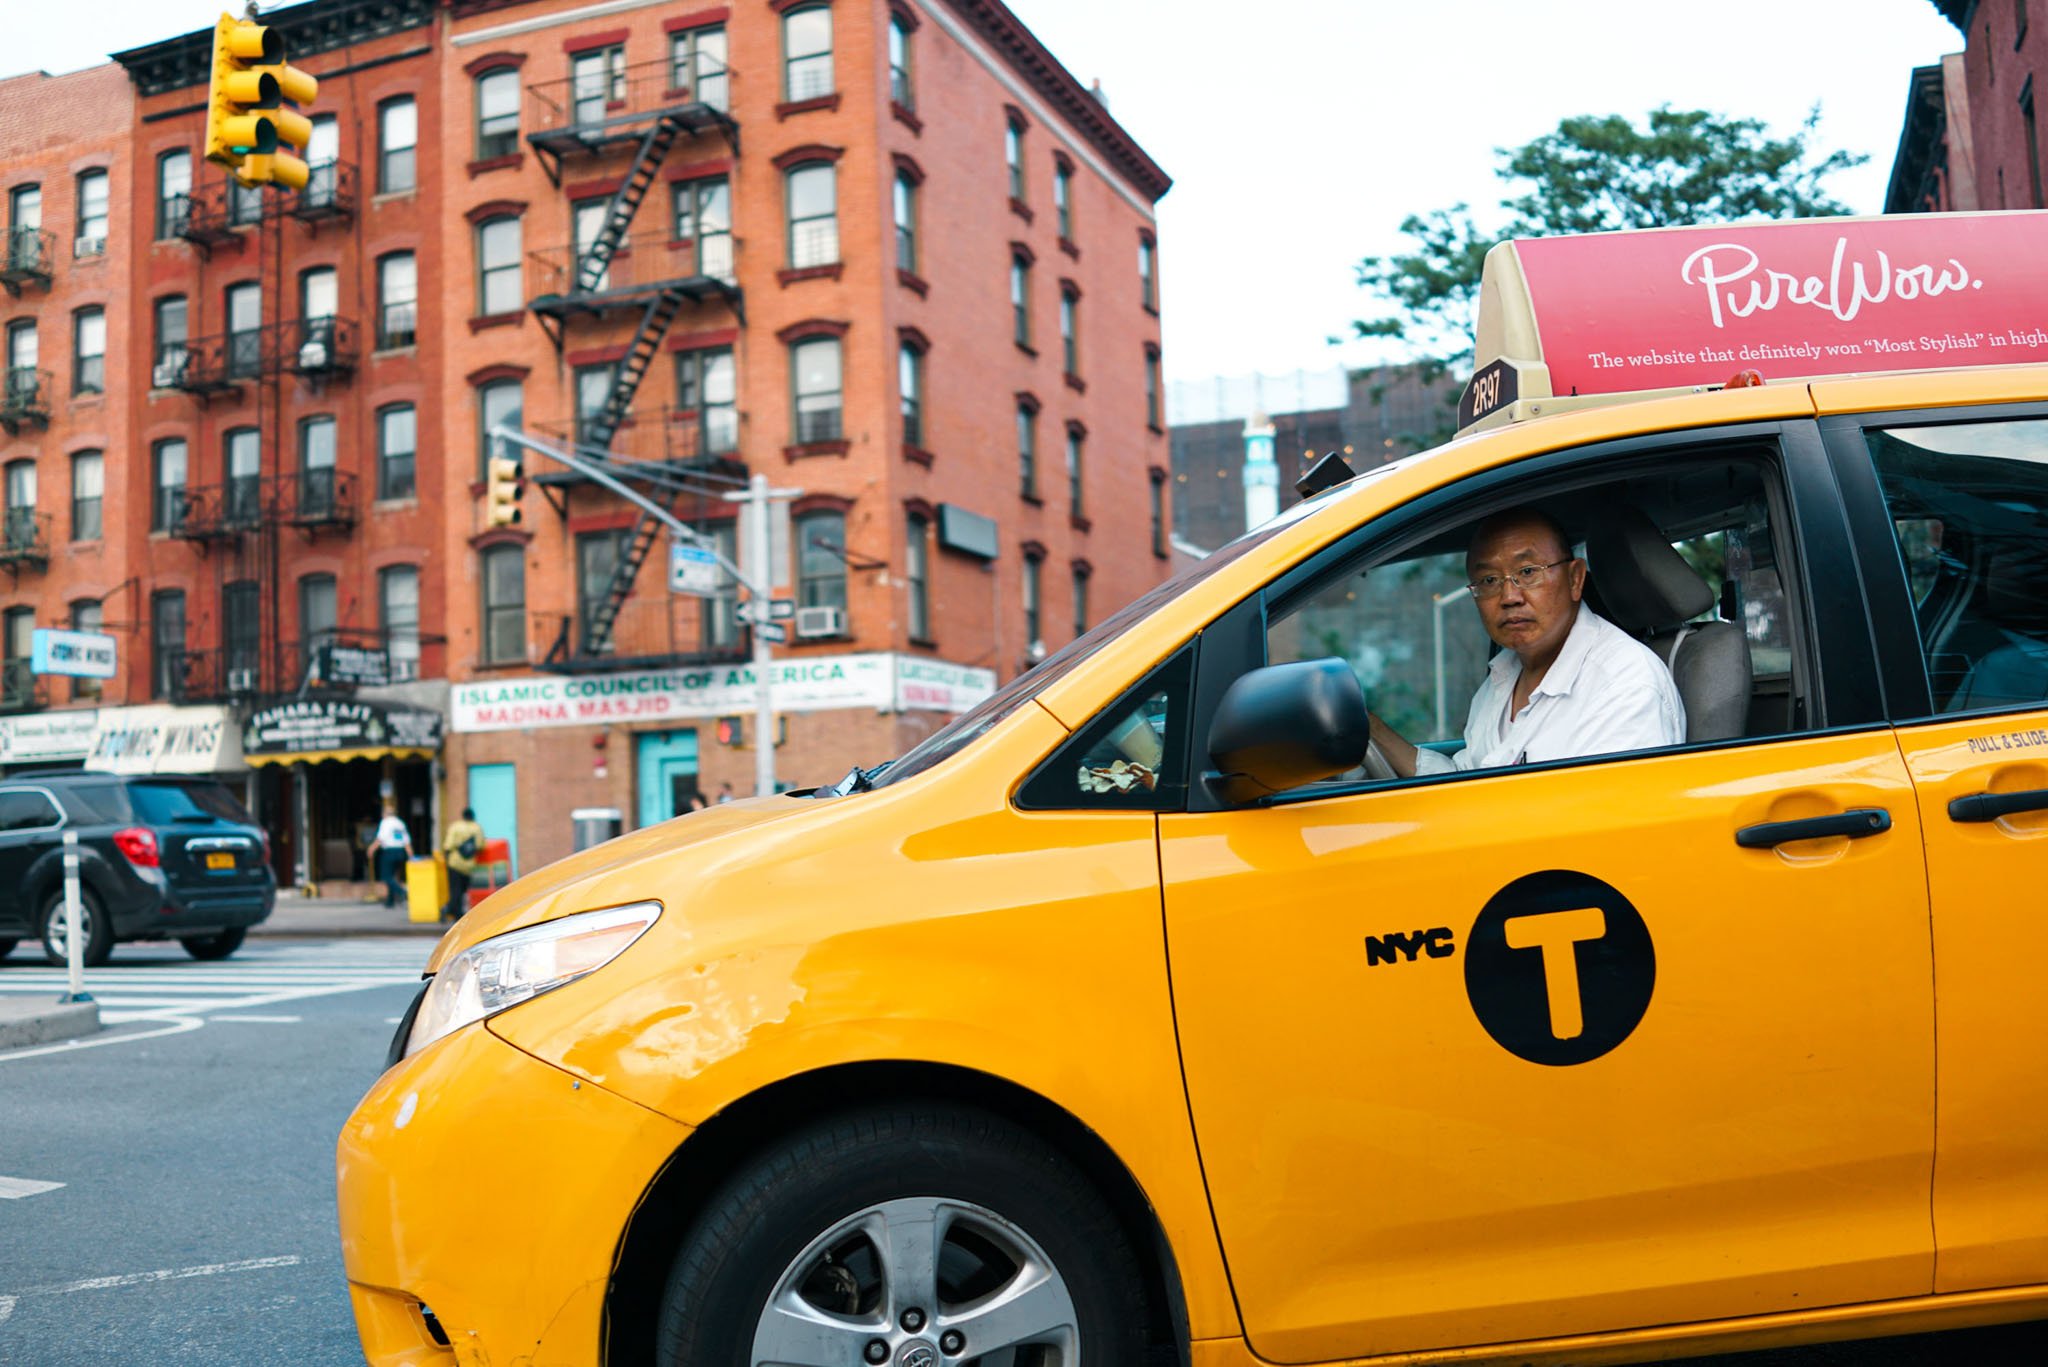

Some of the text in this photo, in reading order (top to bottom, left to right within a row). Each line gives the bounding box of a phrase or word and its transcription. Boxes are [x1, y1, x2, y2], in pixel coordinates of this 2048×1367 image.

[1588, 328, 2048, 369] The website that definitely won “Most Stylish” in high
[1473, 368, 1500, 417] 2R97
[460, 683, 556, 706] ISLAMIC
[564, 675, 674, 699] COUNCIL
[683, 671, 714, 691] OF
[476, 703, 569, 725] MADINA
[578, 696, 671, 718] MASJID
[1968, 729, 2048, 754] PULL & SLIDE
[1365, 907, 1607, 1040] NYC T
